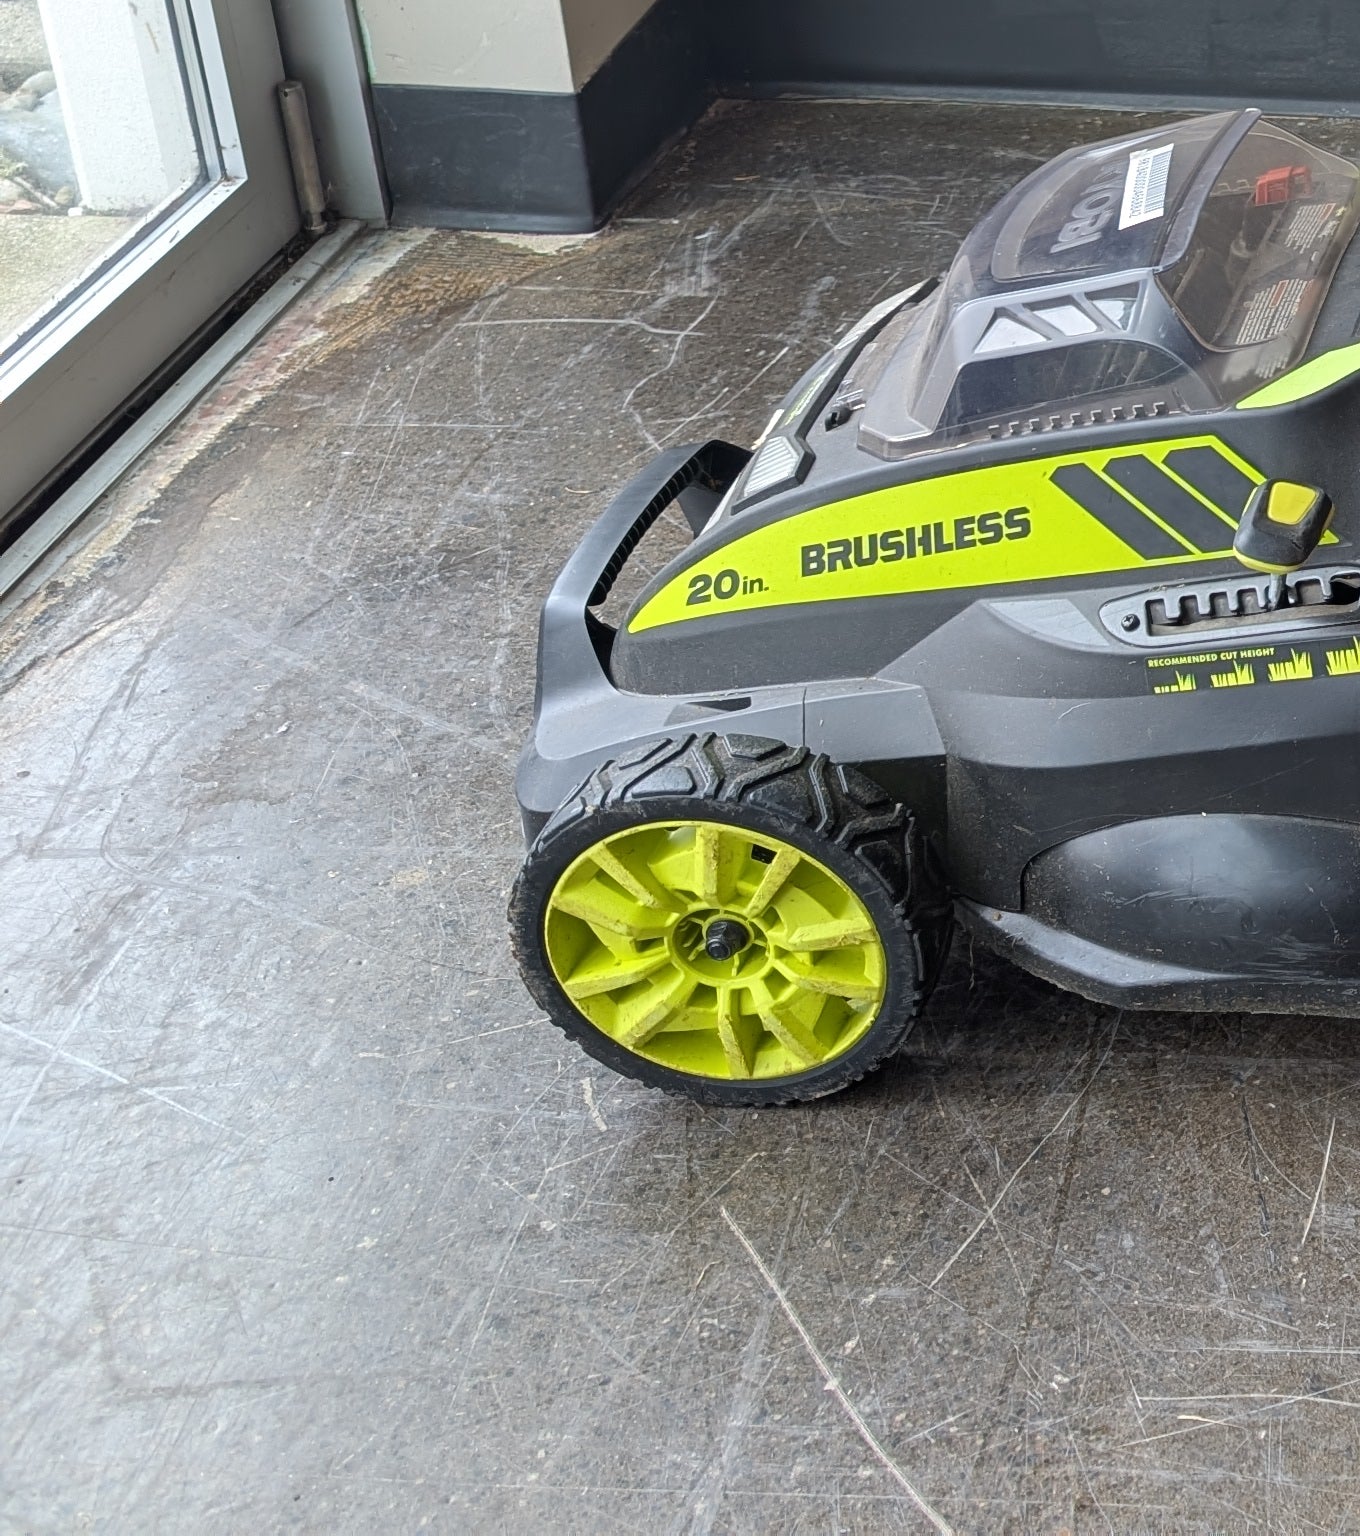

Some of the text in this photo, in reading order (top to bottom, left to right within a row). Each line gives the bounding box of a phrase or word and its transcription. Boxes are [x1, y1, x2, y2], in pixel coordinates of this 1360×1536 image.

[801, 506, 1031, 577] BRUSHLESS
[1148, 647, 1275, 667] RECOMMENDED CUT HEIGHT
